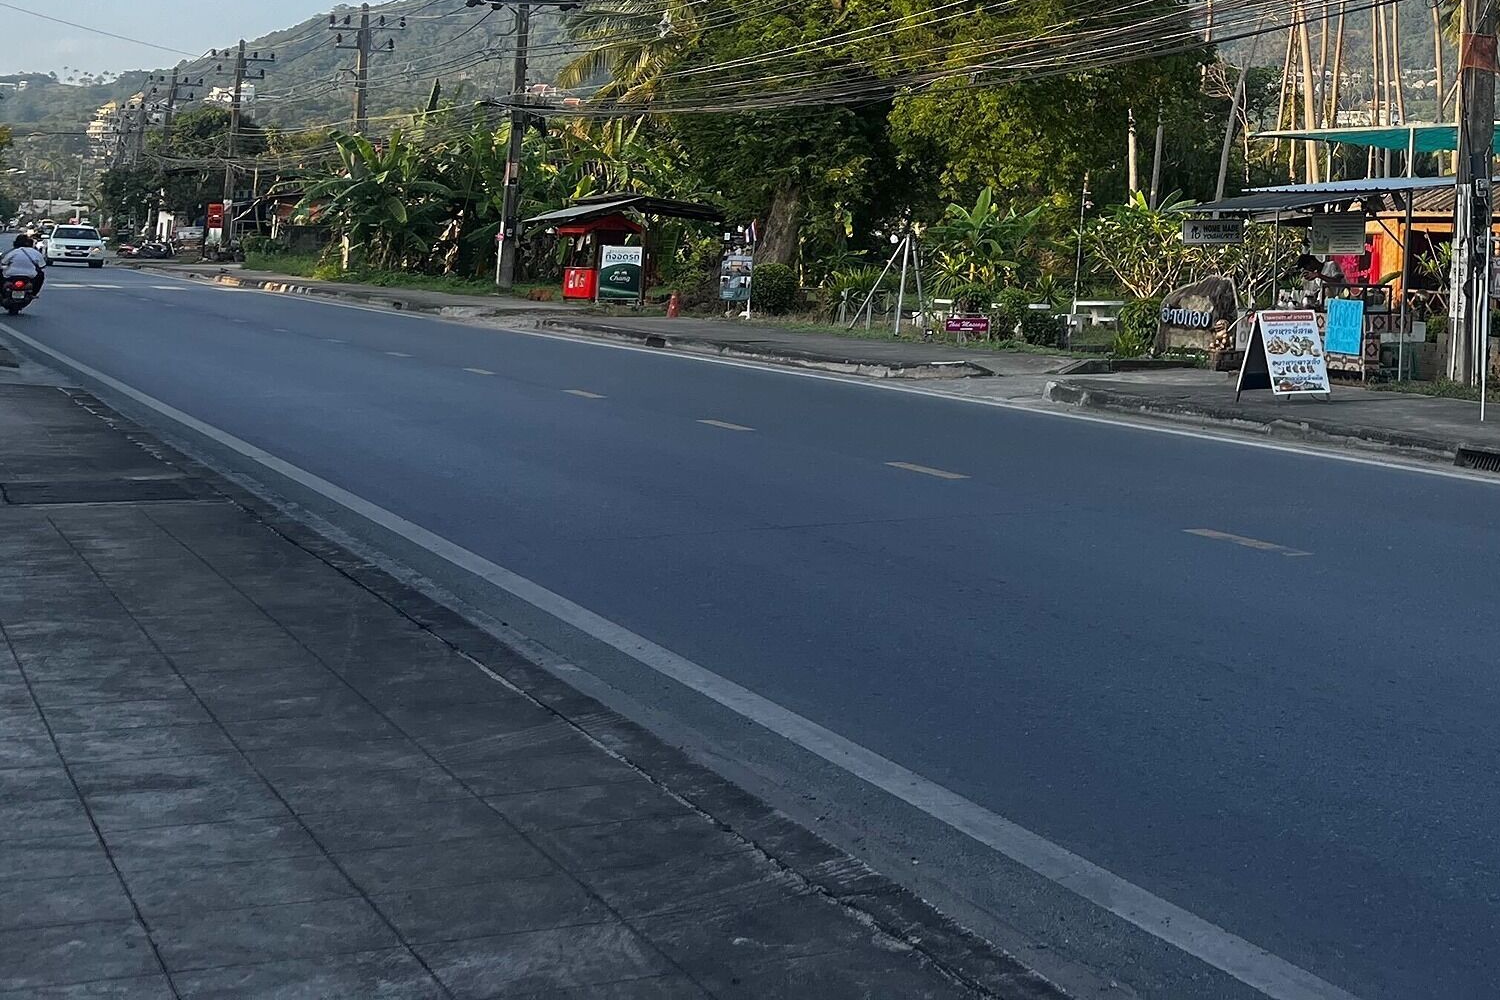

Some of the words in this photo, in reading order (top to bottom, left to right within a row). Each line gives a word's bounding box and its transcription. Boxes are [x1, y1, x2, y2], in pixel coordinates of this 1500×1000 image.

[609, 274, 631, 283] Chang
[948, 320, 960, 328] Thai
[961, 320, 987, 330] Massage
